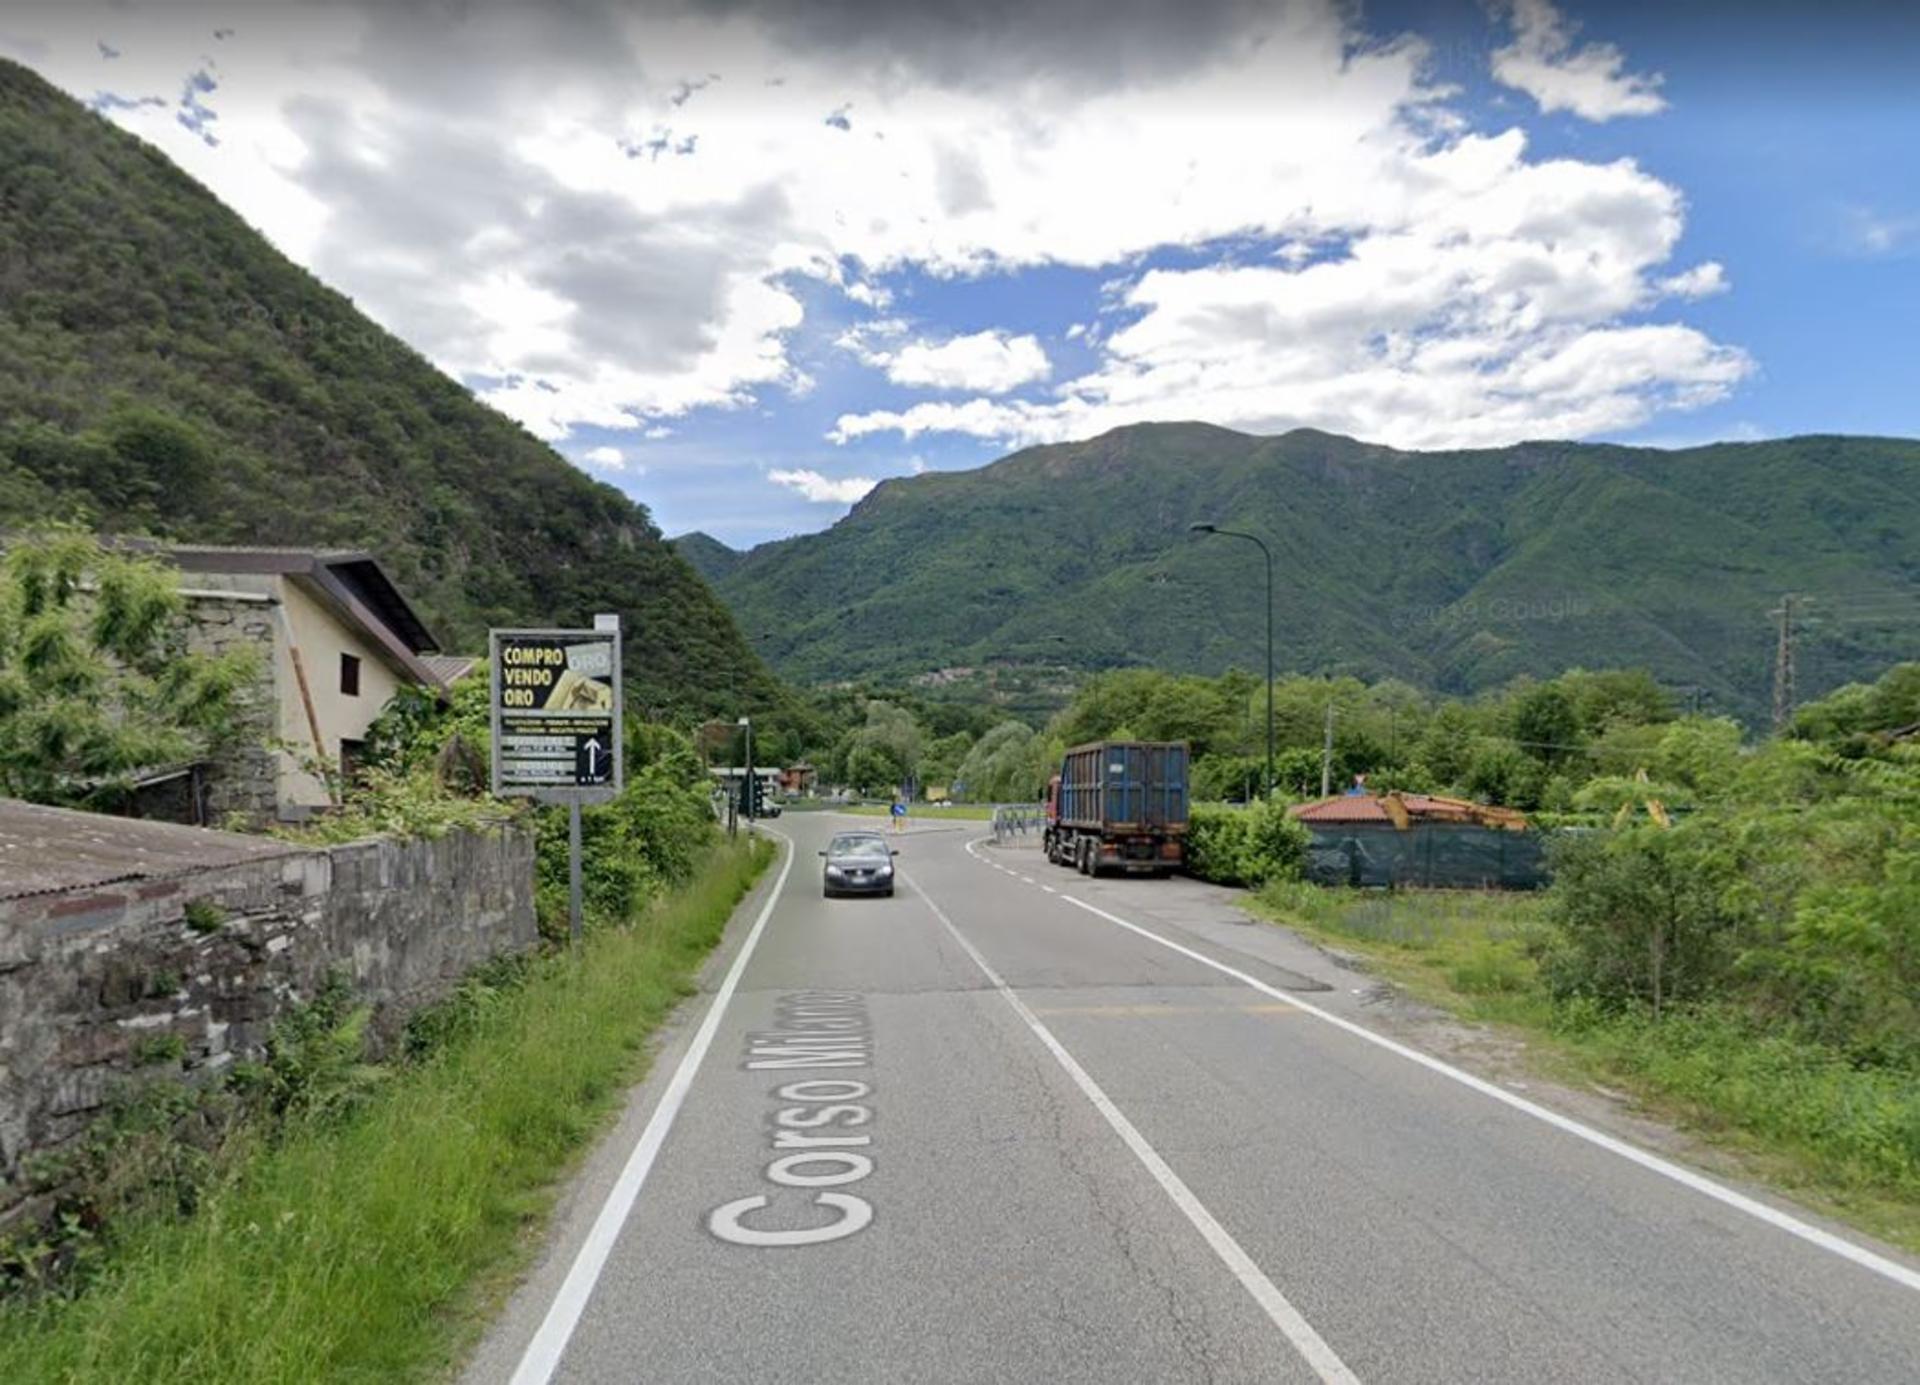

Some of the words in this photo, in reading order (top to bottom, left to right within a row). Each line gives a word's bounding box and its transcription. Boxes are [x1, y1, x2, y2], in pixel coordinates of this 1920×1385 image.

[504, 648, 562, 666] COMPRO
[504, 669, 551, 686] VENDO
[504, 688, 534, 706] ORO
